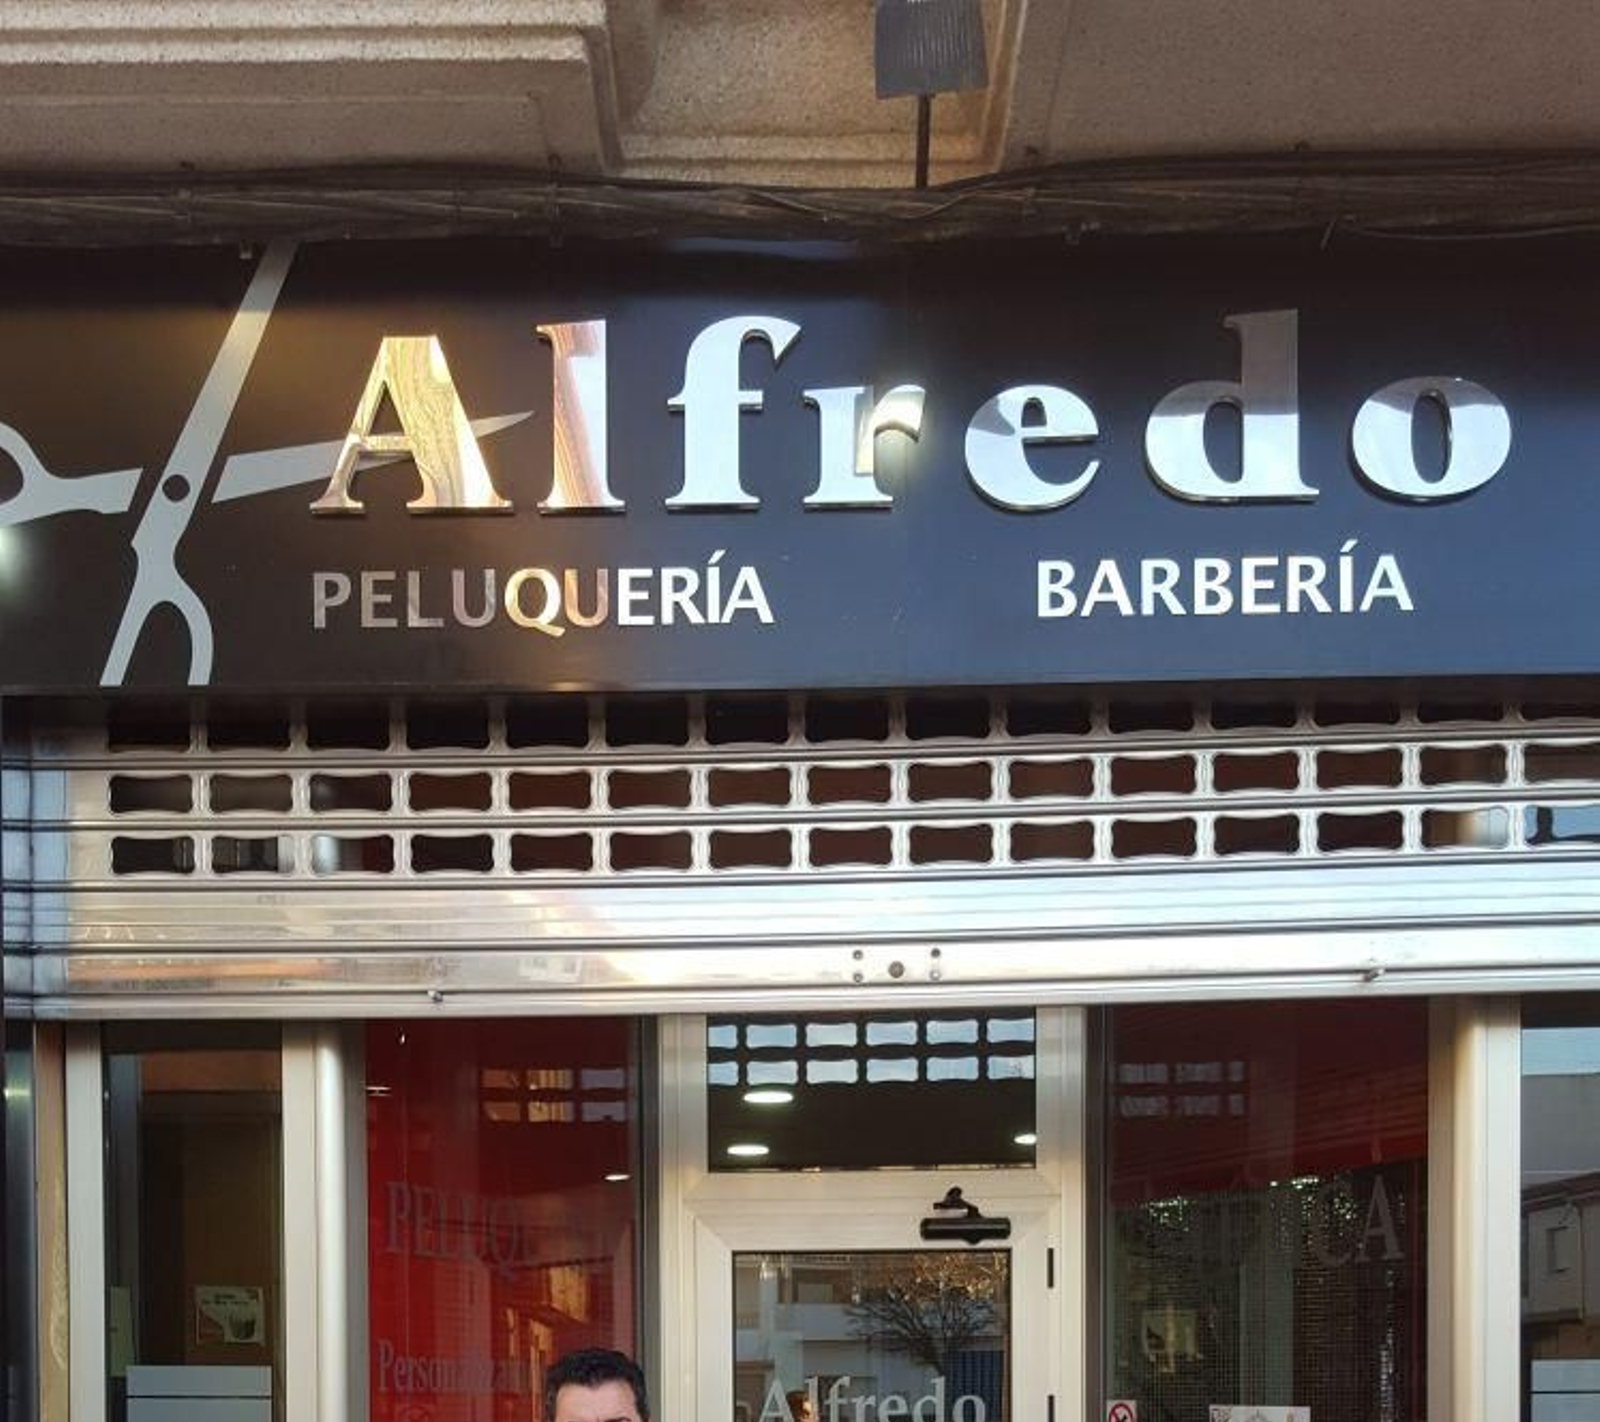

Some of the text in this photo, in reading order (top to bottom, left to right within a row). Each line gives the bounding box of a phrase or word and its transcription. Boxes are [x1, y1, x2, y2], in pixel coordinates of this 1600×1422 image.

[309, 309, 1513, 515] Alfredo
[311, 539, 1415, 637] PELUQUERÍA BARBERÍA
